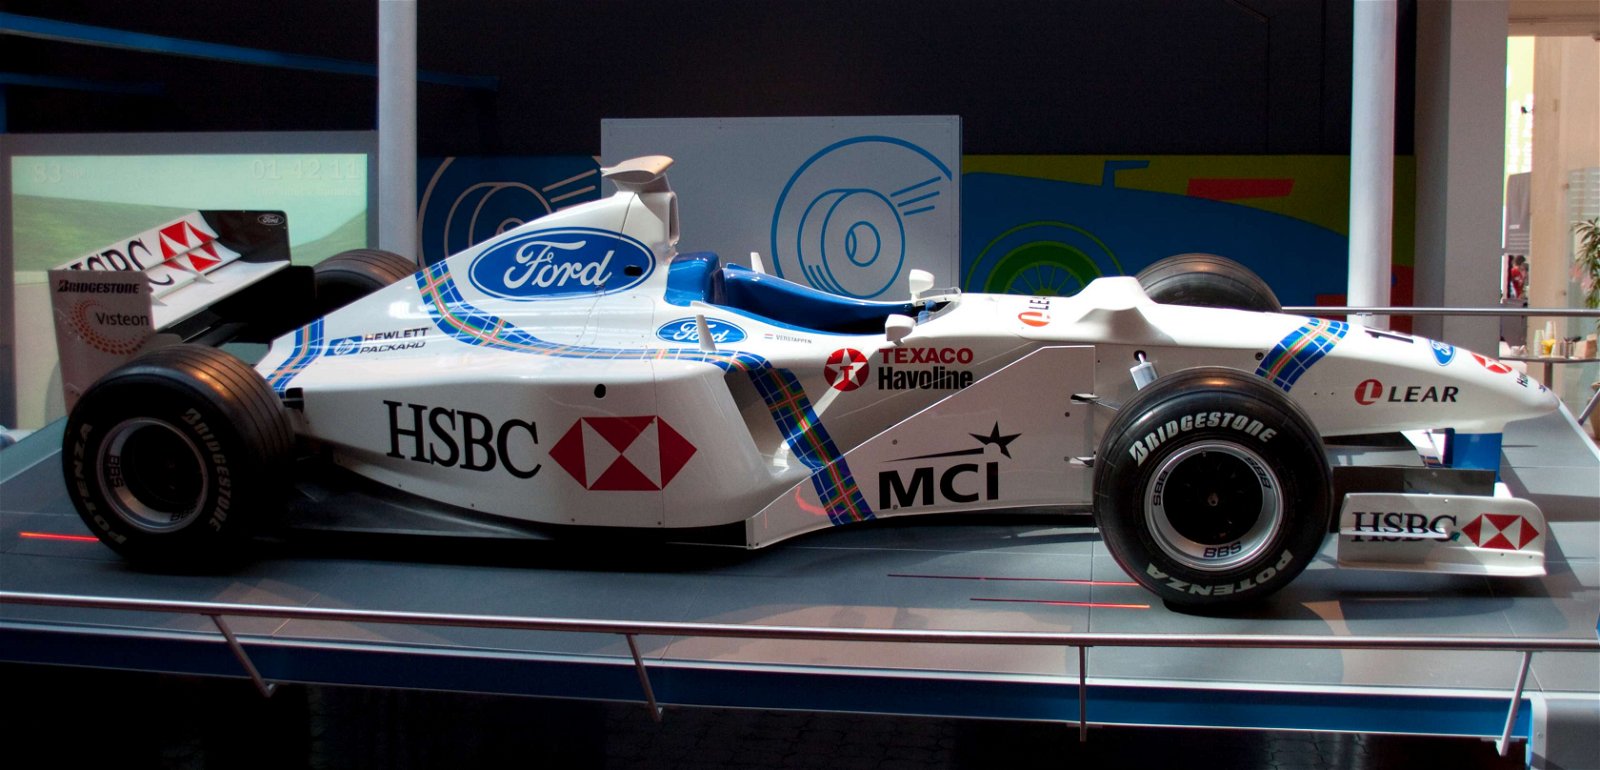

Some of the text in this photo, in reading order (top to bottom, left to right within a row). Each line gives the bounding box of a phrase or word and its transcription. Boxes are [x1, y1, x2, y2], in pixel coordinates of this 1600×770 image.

[503, 240, 615, 289] Ford
[57, 279, 140, 294] BRIDGESTONE
[96, 311, 149, 326] Visteon
[364, 327, 429, 341] HEWLETT
[673, 321, 729, 342] Fod
[360, 341, 425, 353] PACKARD
[878, 347, 973, 365] TEXACO
[878, 366, 973, 390] Havoline
[1388, 386, 1459, 402] LEAR
[383, 400, 542, 479] HSBC
[1128, 411, 1277, 467] BRIDGESTONE
[1246, 456, 1272, 489] BBS
[878, 461, 999, 510] MCI
[1152, 470, 1168, 506] BBS
[1350, 511, 1457, 543] HSBC
[1203, 541, 1242, 558] BBS
[1146, 549, 1294, 597] POTENZA
